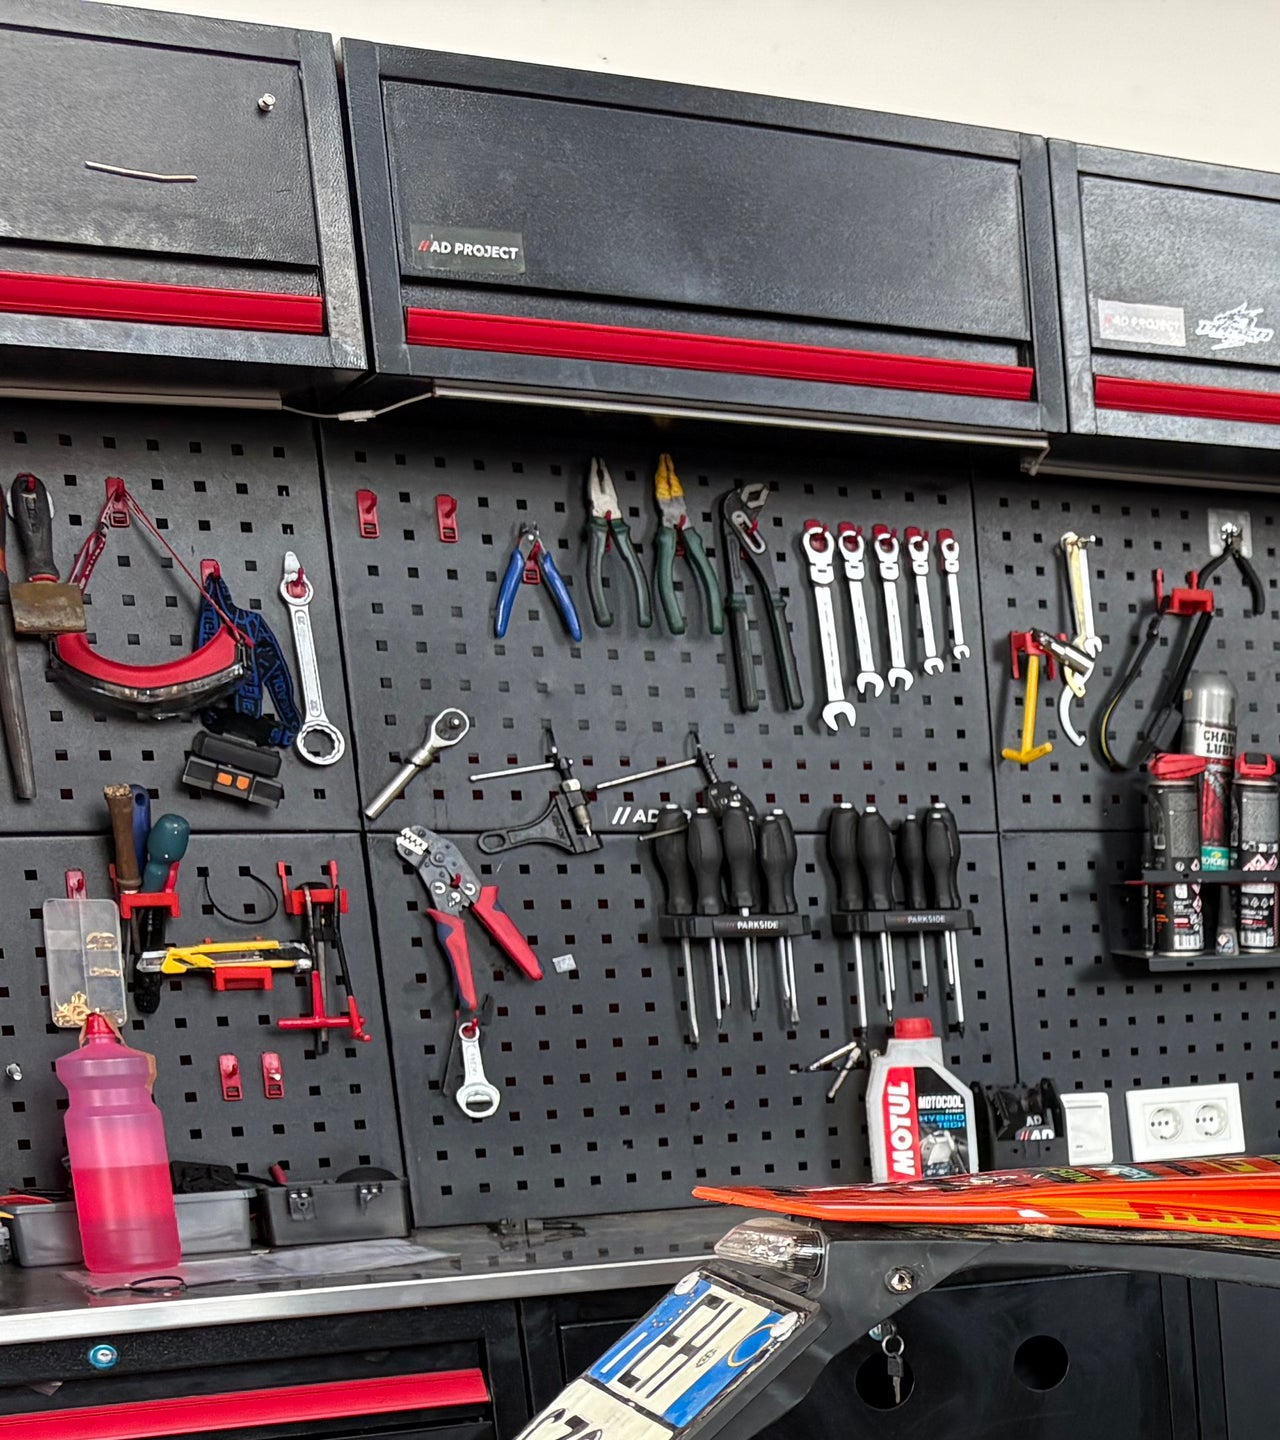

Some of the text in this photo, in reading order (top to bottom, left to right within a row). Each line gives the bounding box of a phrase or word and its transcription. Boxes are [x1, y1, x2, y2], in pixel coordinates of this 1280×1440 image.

[454, 243, 518, 260] PROJECT
[737, 920, 779, 930] PARKSIDE
[907, 914, 946, 925] PARKSIDE
[918, 1094, 964, 1110] MOTOCOOL
[920, 1113, 965, 1123] HYBRID
[887, 1081, 915, 1176] MOTUL
[937, 1121, 966, 1129] TECH
[617, 1295, 744, 1399] EH
